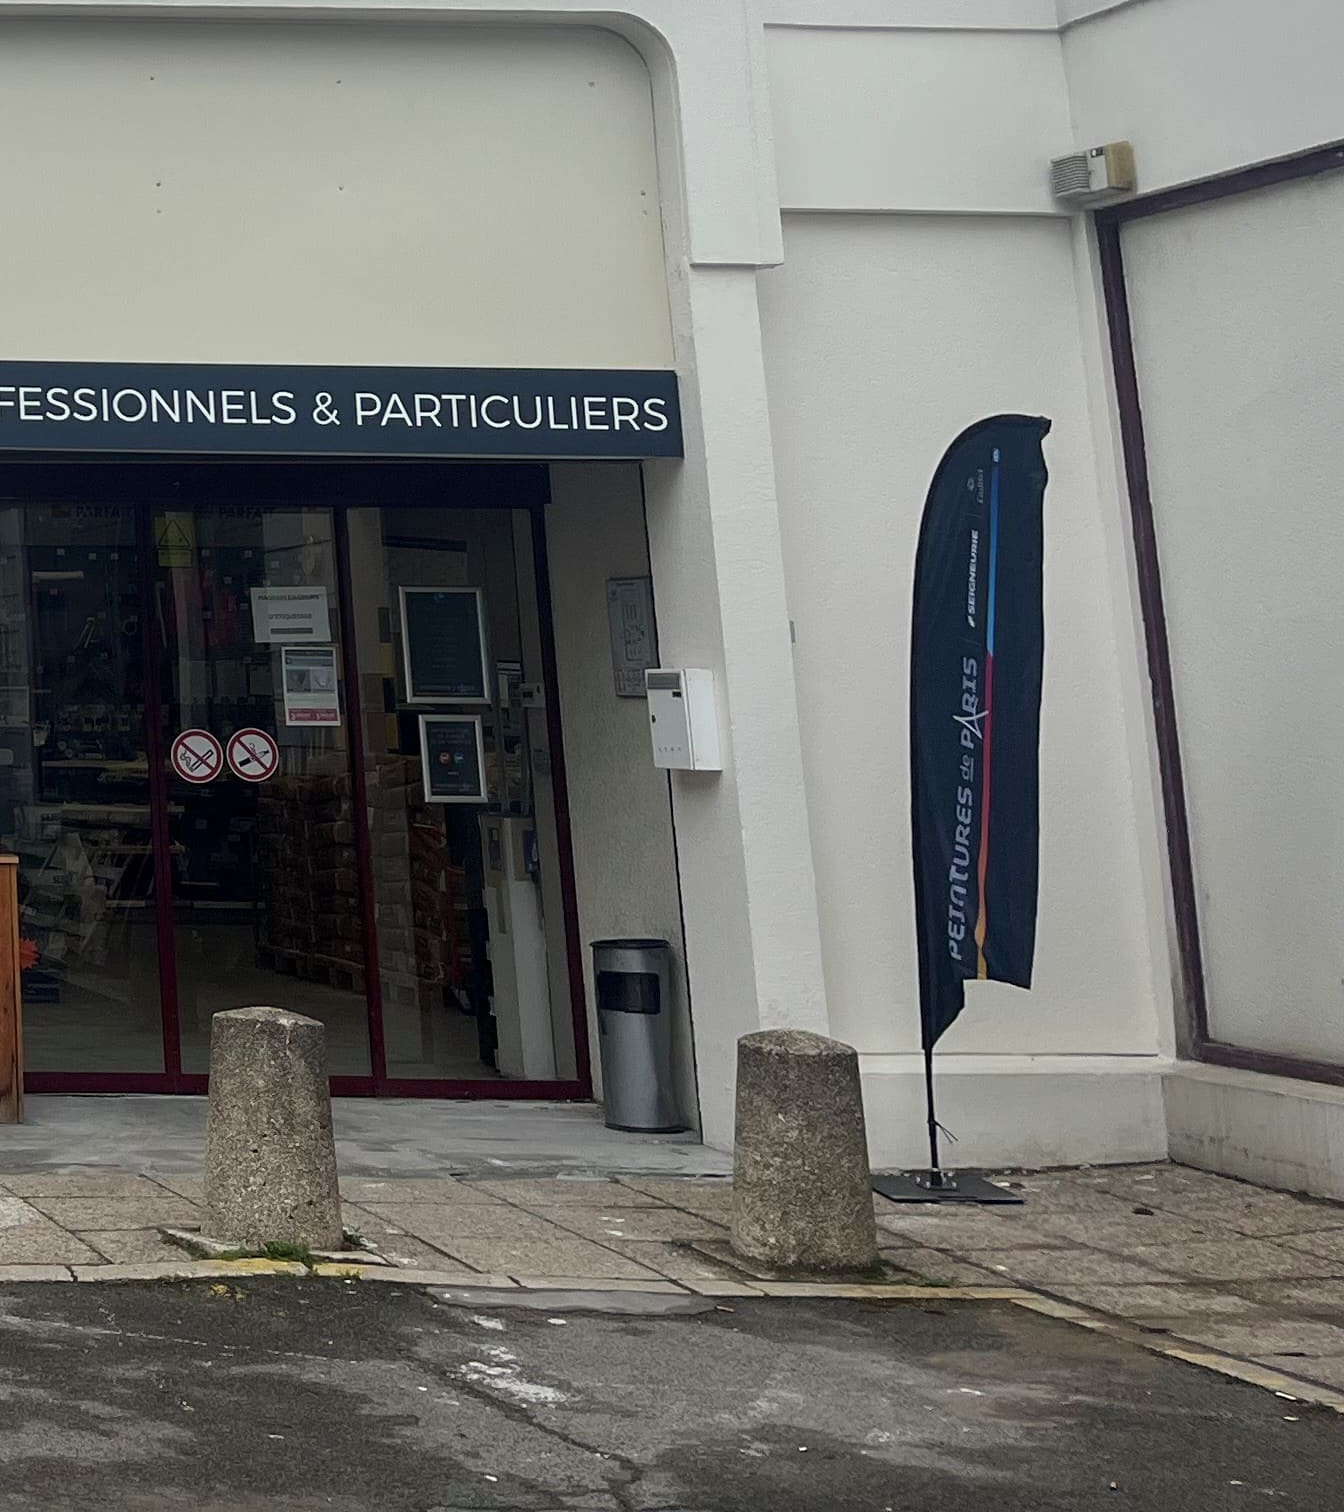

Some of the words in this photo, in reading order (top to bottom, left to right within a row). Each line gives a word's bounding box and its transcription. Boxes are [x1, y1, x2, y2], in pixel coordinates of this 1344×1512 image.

[312, 392, 341, 425] &
[355, 392, 669, 433] PARTICULIERS
[952, 656, 990, 750] PARIS
[959, 755, 975, 782] de
[947, 785, 974, 961] PEINTURES
